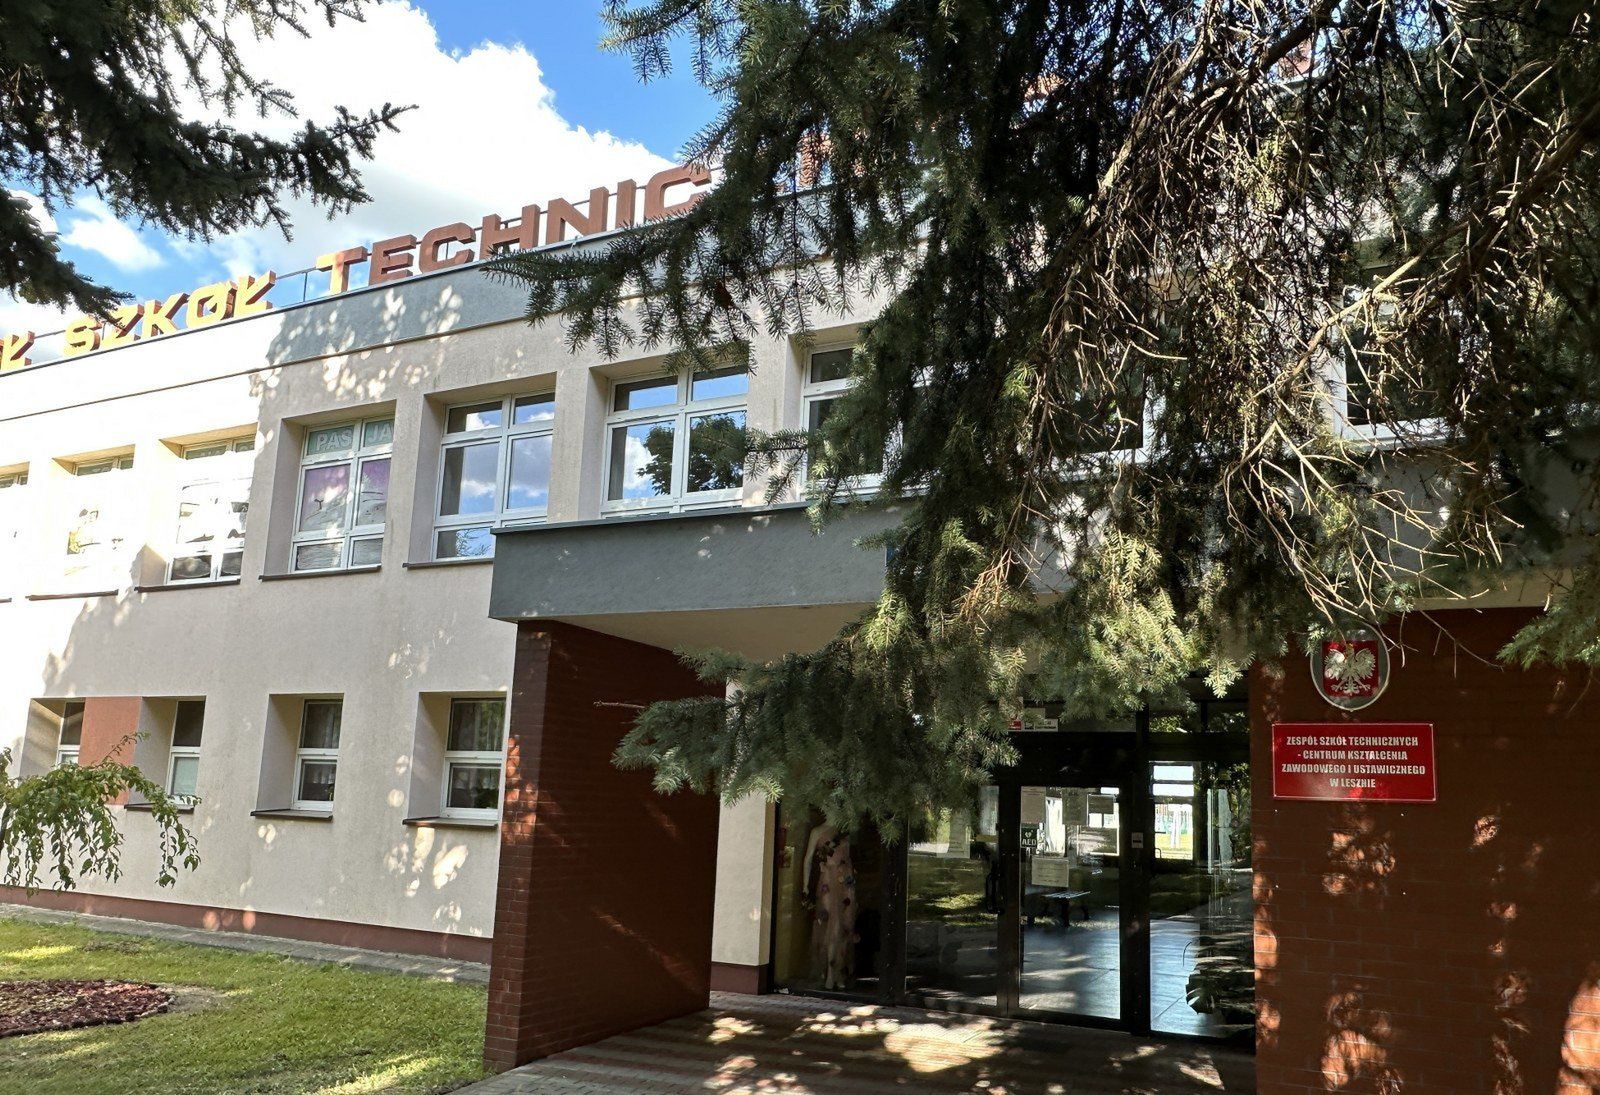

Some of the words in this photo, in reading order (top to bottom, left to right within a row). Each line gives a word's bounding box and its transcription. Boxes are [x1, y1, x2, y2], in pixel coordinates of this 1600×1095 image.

[316, 164, 713, 297] TECHNIC
[1286, 736, 1318, 746] ZESPÓŁ
[1319, 735, 1347, 747] SZKÓŁ
[1348, 736, 1418, 746] TECHNICZNYCH
[1302, 750, 1346, 760] CENTRUM
[1347, 750, 1408, 760] KSZTAŁCENIA
[1281, 763, 1346, 773] ZAWODOWEGO
[1353, 764, 1426, 775] USTAWICZNEGO
[1329, 778, 1340, 787] W
[1341, 778, 1376, 788] LESZNIE
